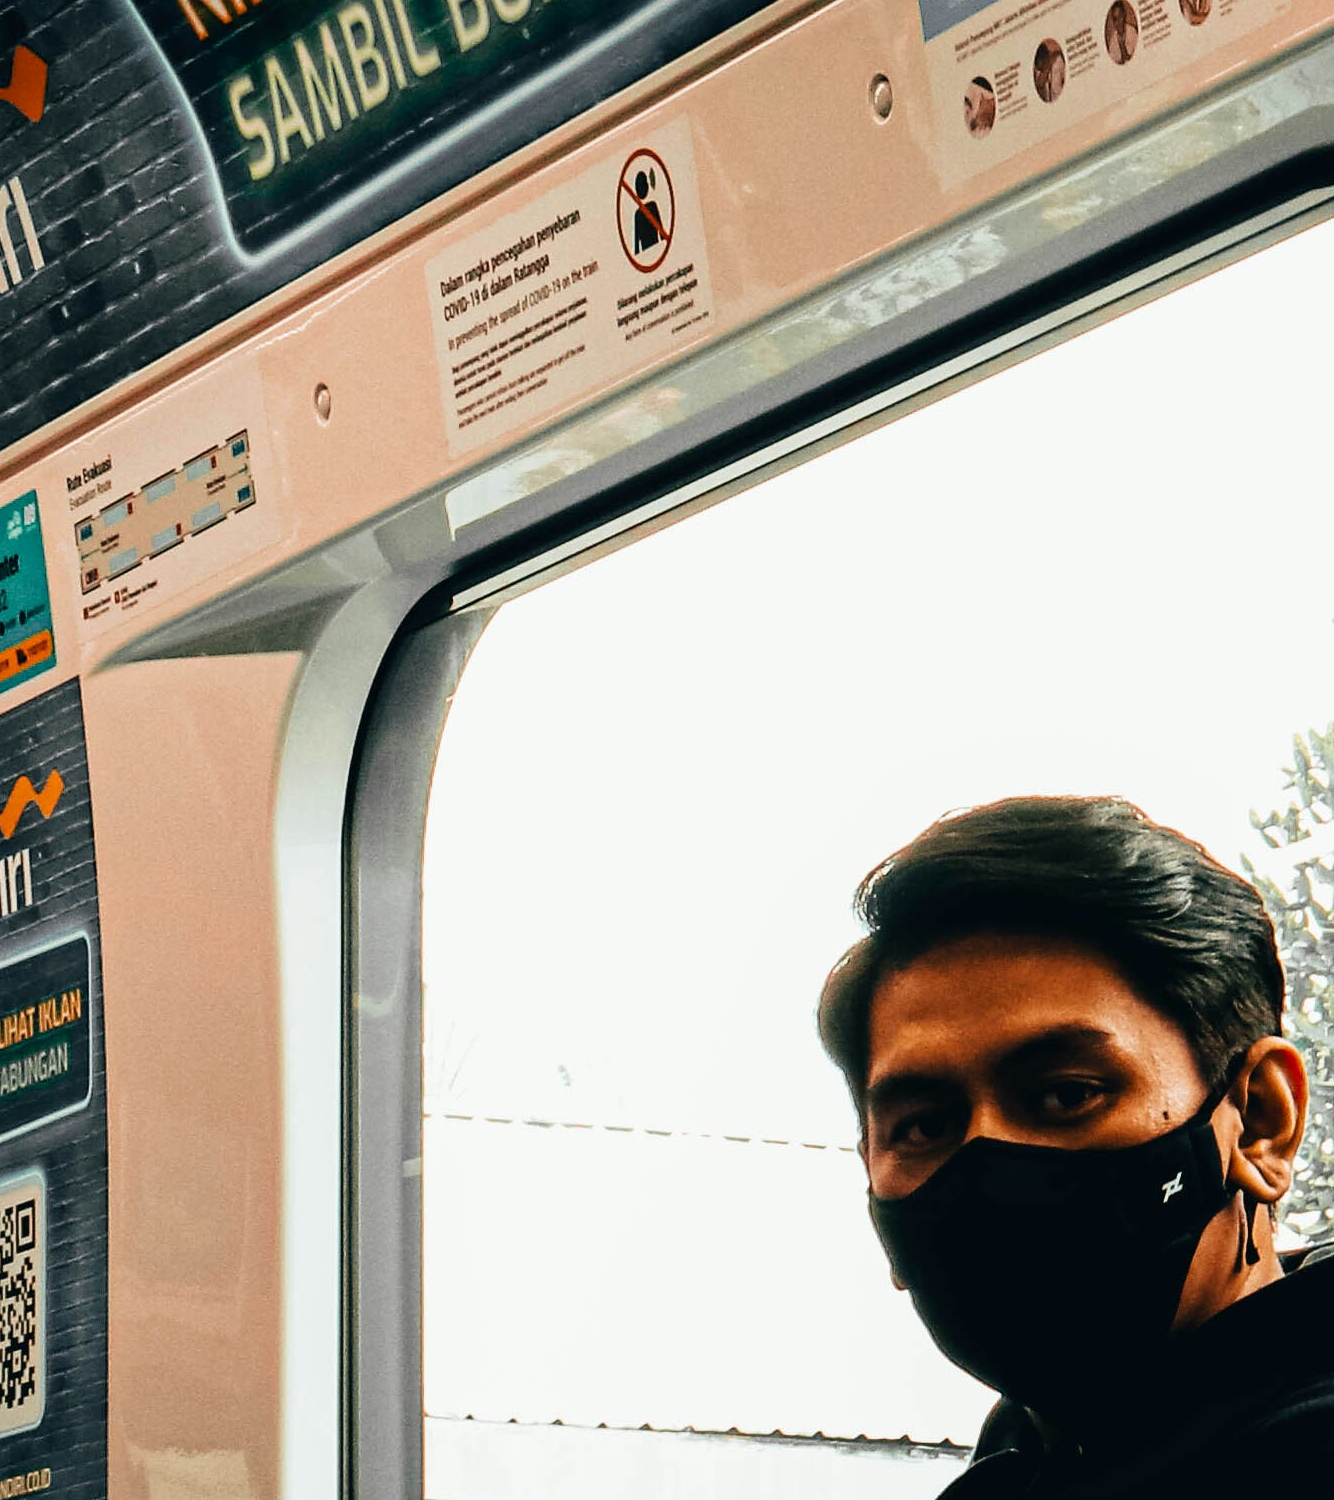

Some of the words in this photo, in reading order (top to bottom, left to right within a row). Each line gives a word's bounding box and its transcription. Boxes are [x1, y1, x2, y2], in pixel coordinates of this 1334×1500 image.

[440, 275, 464, 298] Dalam
[463, 258, 490, 283] rangka
[491, 235, 536, 273] pencegahan
[535, 209, 582, 249] penyebaran
[529, 278, 562, 307] COVID-19
[582, 258, 600, 280] train
[443, 288, 481, 323] COVID-19
[480, 283, 489, 301] di
[490, 274, 514, 297] dalam
[513, 253, 550, 284] Ratangga
[38, 987, 83, 1034] IKLAN
